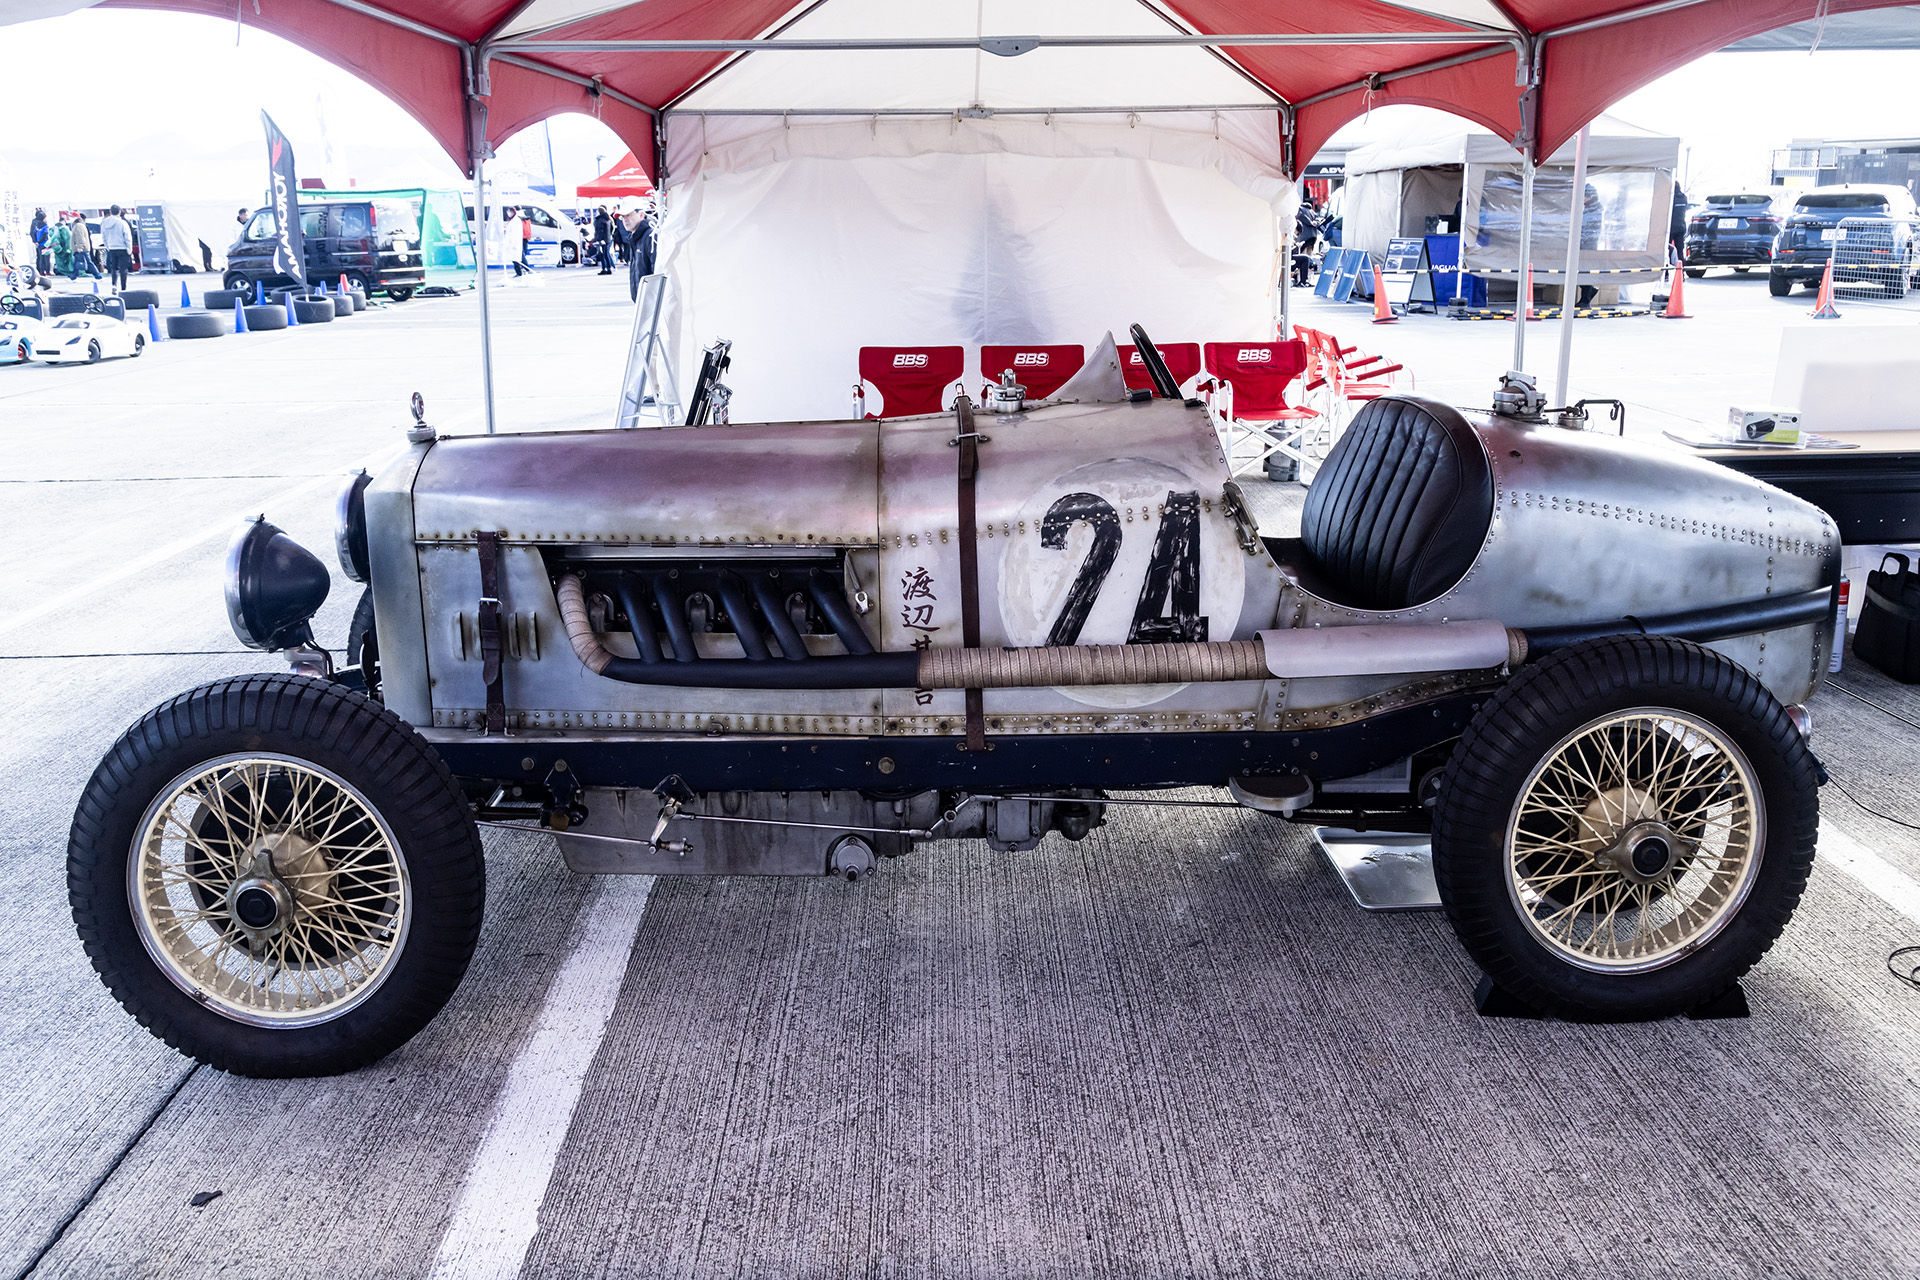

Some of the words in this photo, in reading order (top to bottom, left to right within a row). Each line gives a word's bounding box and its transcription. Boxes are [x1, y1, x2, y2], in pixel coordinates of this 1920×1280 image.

[272, 171, 302, 279] YOKOHAMA
[892, 354, 928, 368] BBS
[1013, 353, 1049, 367] BBS
[1237, 349, 1272, 363] BBS
[1041, 490, 1209, 647] 24
